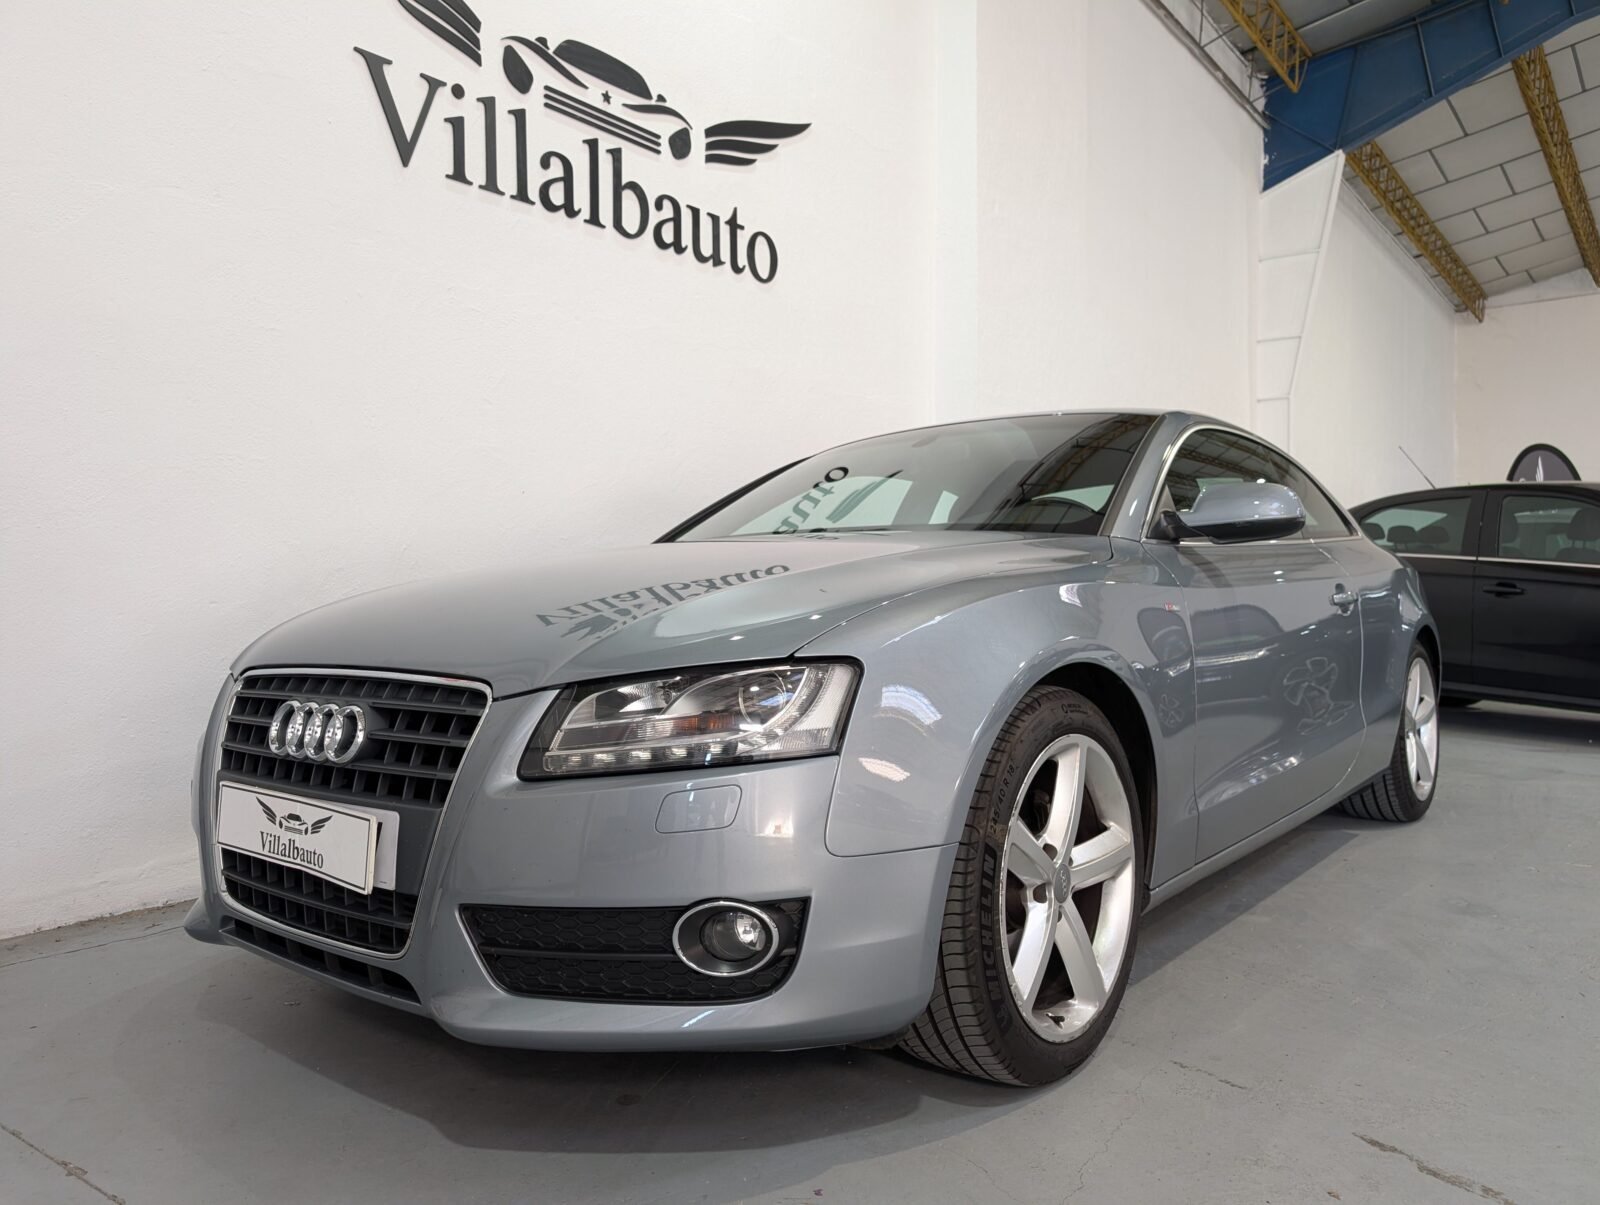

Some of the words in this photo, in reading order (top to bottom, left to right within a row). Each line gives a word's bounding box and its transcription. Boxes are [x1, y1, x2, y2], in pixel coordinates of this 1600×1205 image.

[353, 46, 778, 284] Villalbauto
[260, 831, 323, 868] Villalbauto
[981, 852, 1001, 1000] MICHELIN
